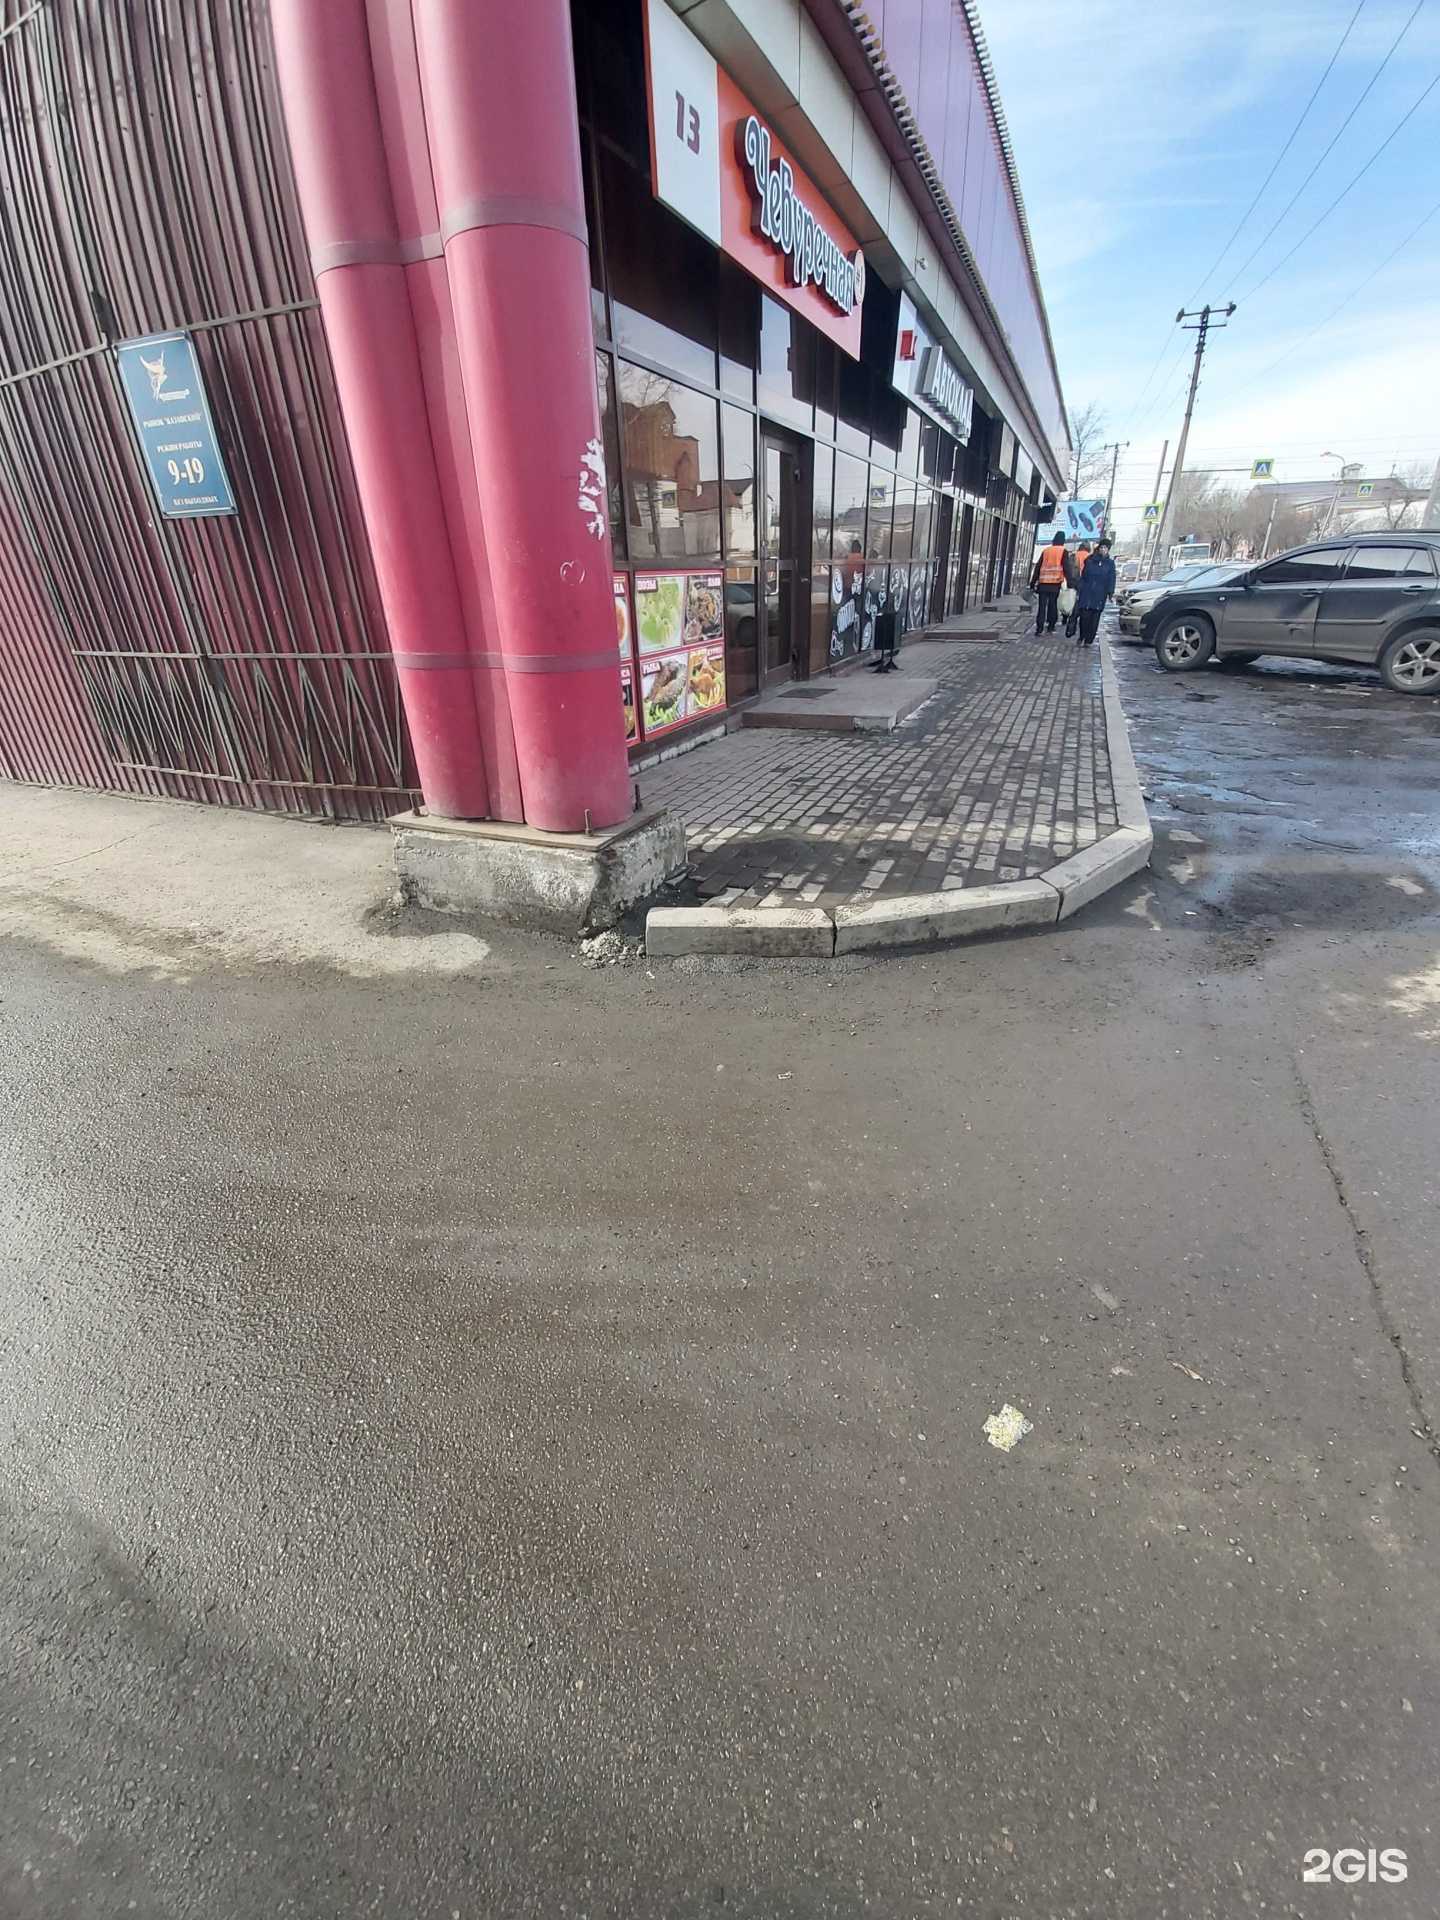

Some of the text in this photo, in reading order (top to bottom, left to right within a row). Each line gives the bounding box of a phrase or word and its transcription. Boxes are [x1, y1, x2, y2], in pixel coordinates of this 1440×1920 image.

[674, 90, 701, 155] 13
[744, 114, 855, 316] Чебуречная
[167, 457, 205, 486] 9-19
